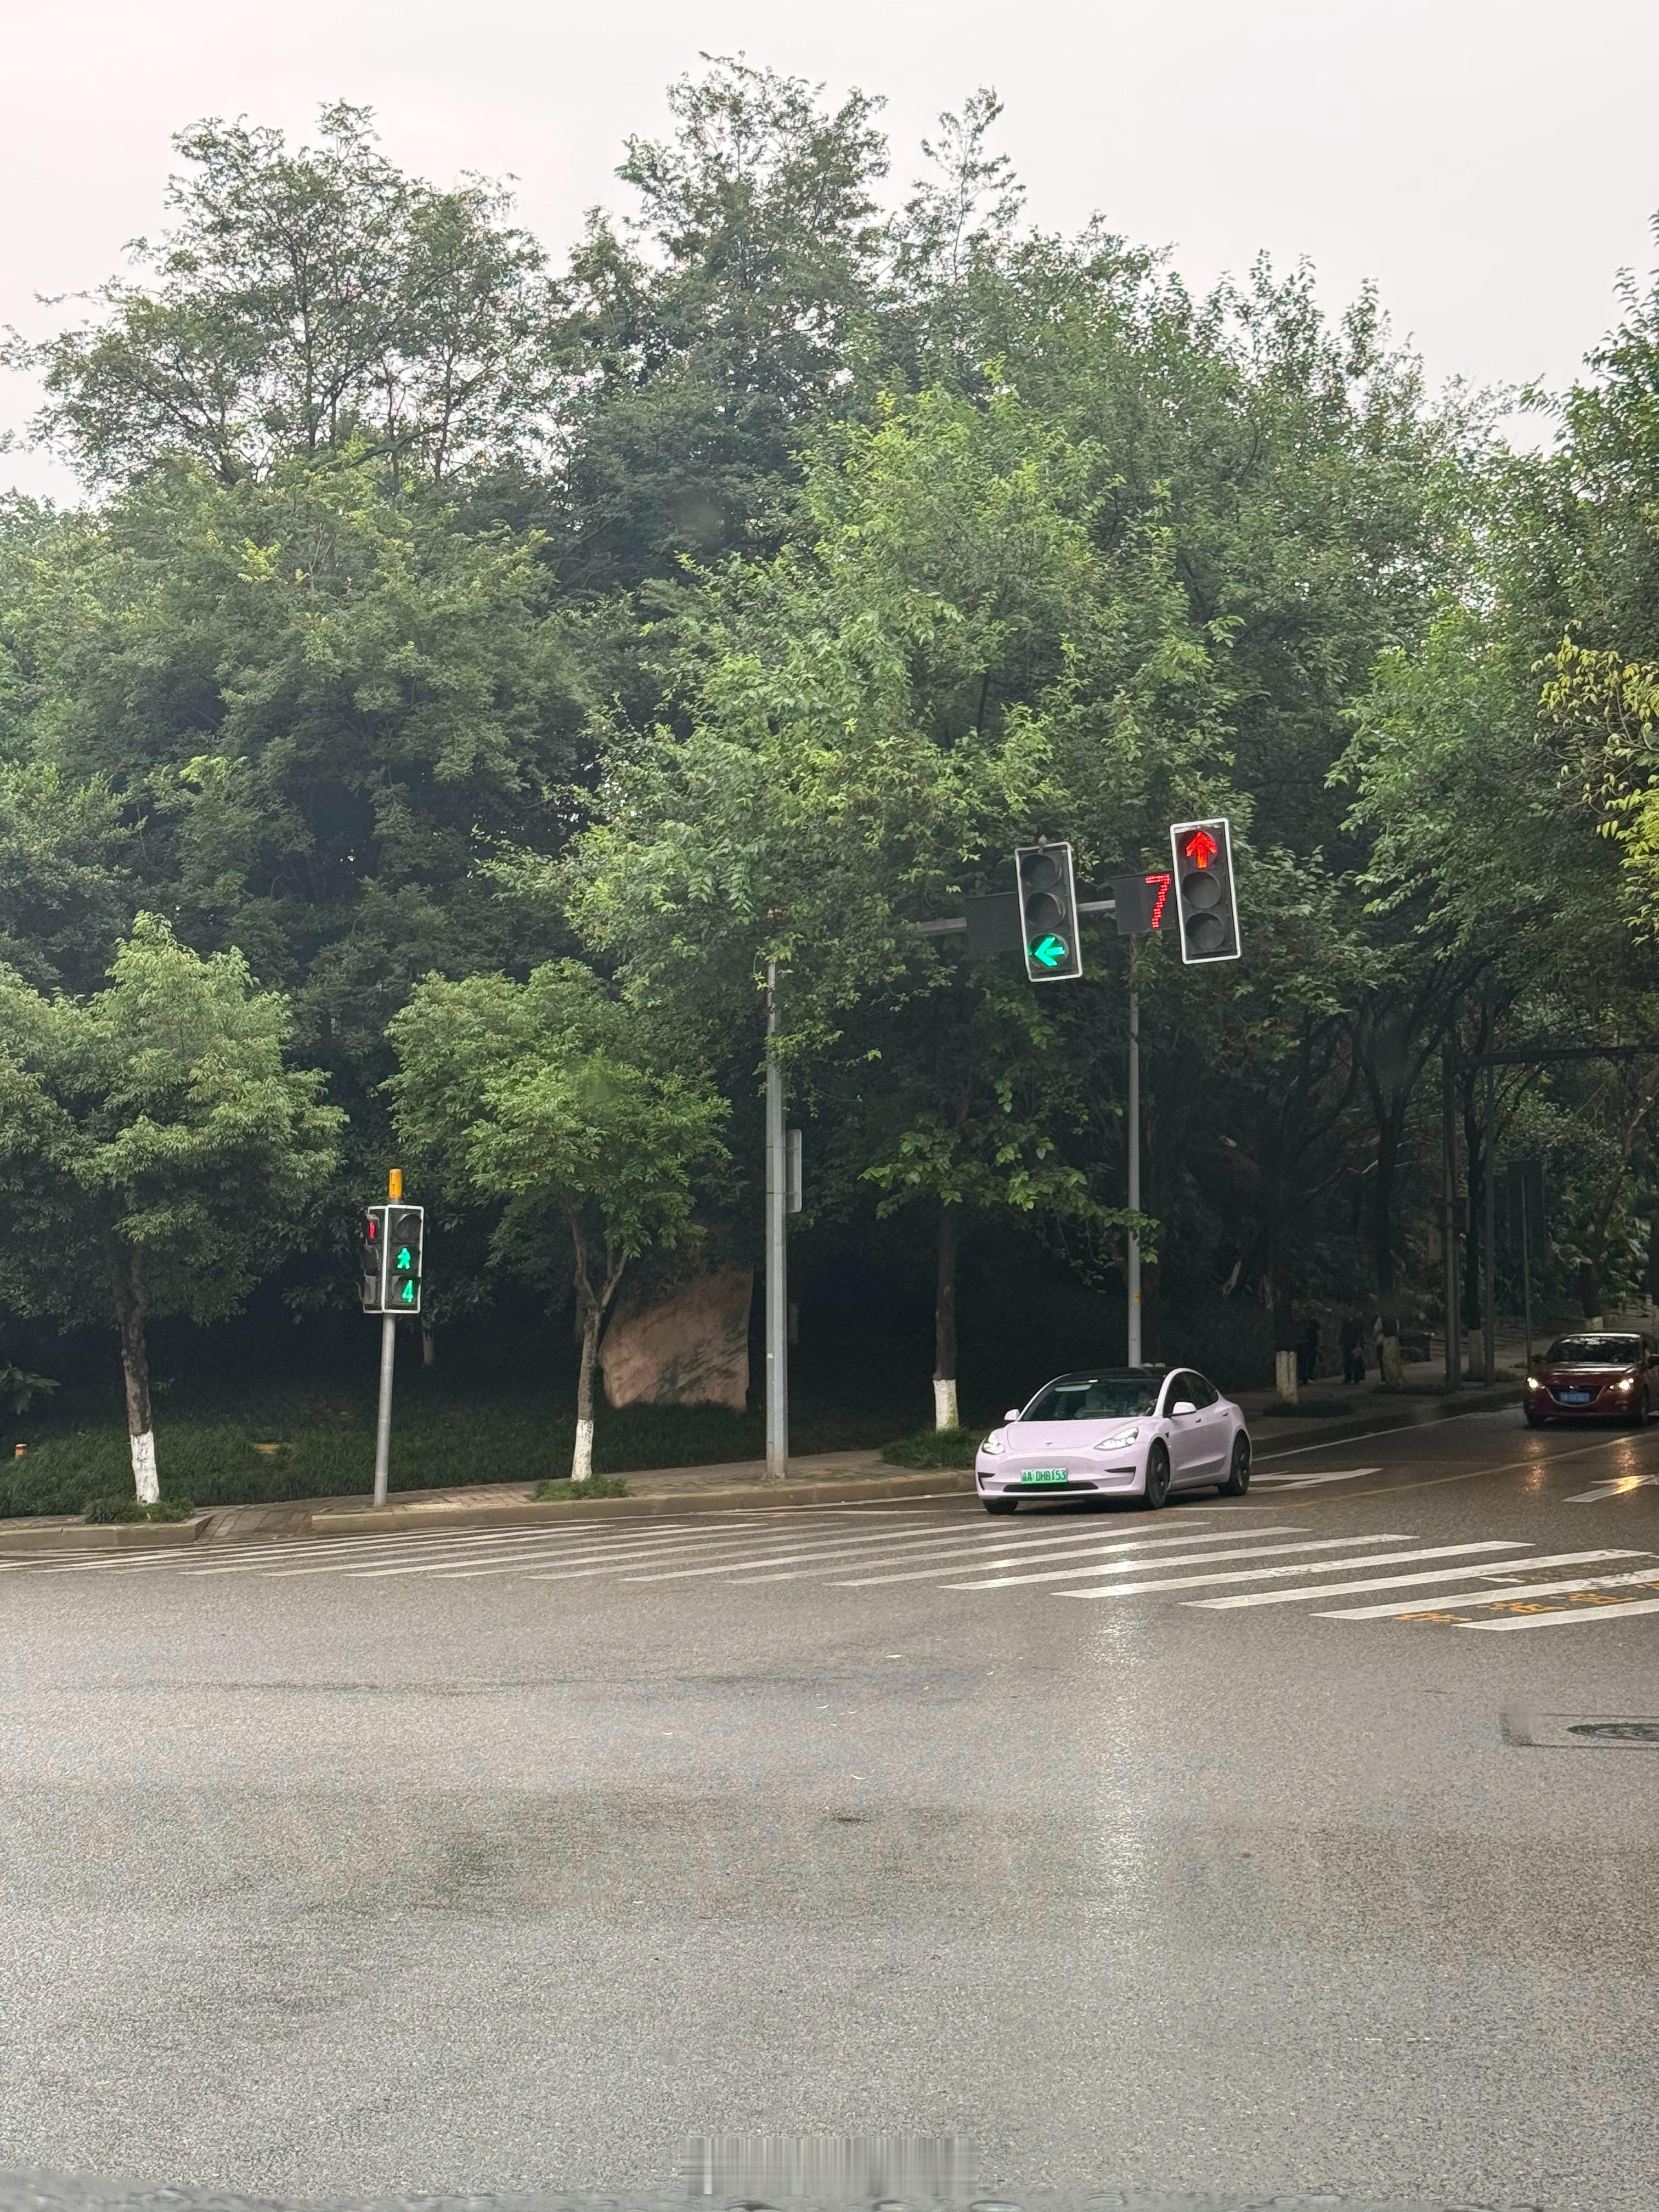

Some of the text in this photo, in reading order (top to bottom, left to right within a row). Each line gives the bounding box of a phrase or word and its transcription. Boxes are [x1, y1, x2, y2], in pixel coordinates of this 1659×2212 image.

[1144, 873, 1171, 928] 7
[402, 1279, 414, 1303] 4
[1036, 1470, 1066, 1481] DH8153
